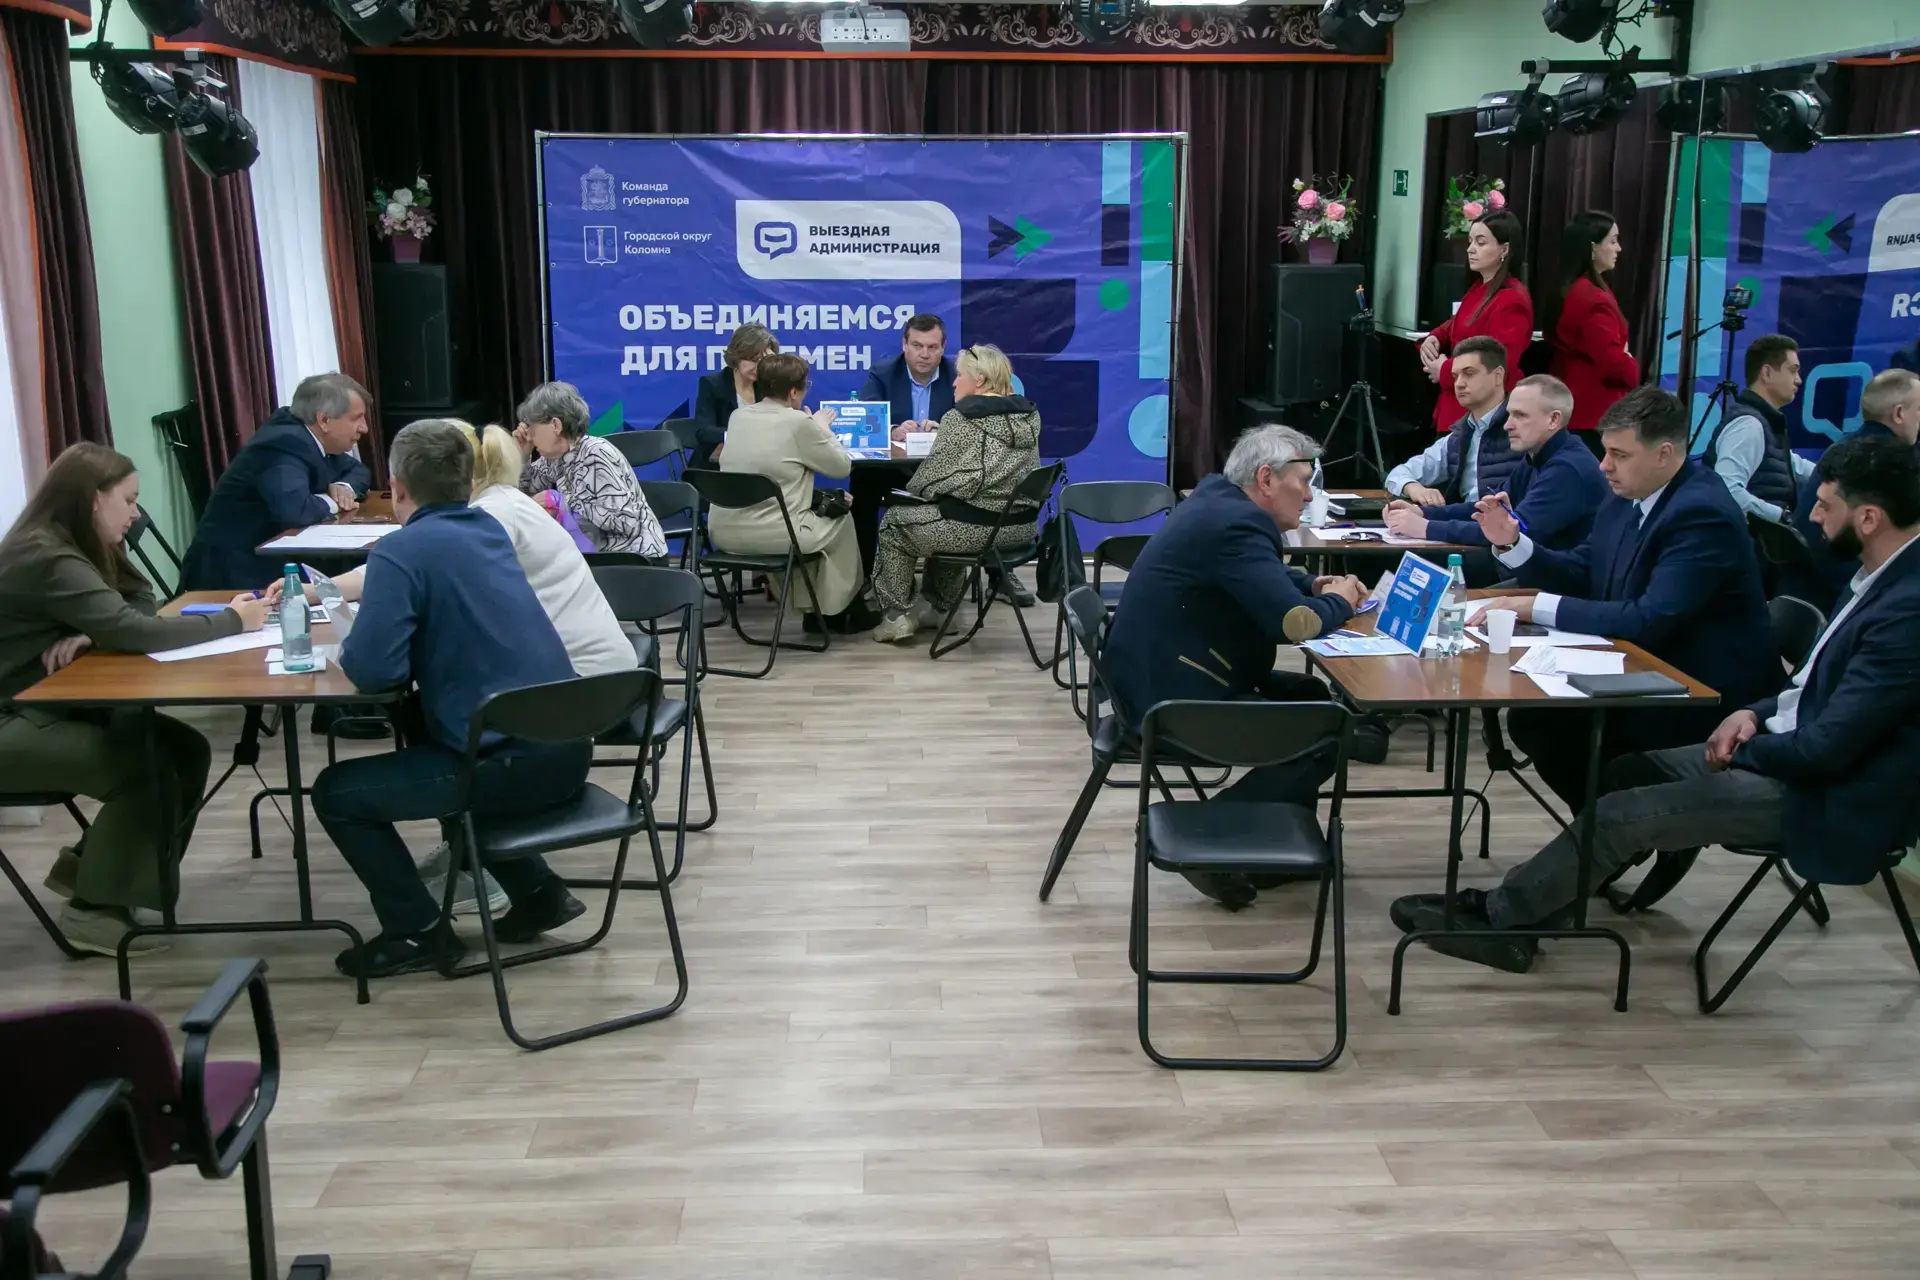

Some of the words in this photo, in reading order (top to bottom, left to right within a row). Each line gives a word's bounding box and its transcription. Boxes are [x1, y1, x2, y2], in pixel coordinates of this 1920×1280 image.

[622, 182, 668, 191] Команда
[622, 196, 689, 206] губернатора
[624, 231, 679, 242] Городской
[682, 234, 712, 242] округ
[809, 226, 890, 238] ВЫЕЗДНАЯ
[625, 245, 671, 254] Коломна
[809, 243, 940, 255] АДМИНИСТРАЦИЯ
[619, 305, 915, 334] ОБЪЕДИНЯЕМСЯ
[621, 346, 697, 375] ДЛЯ
[706, 346, 872, 371] ПМЕН
